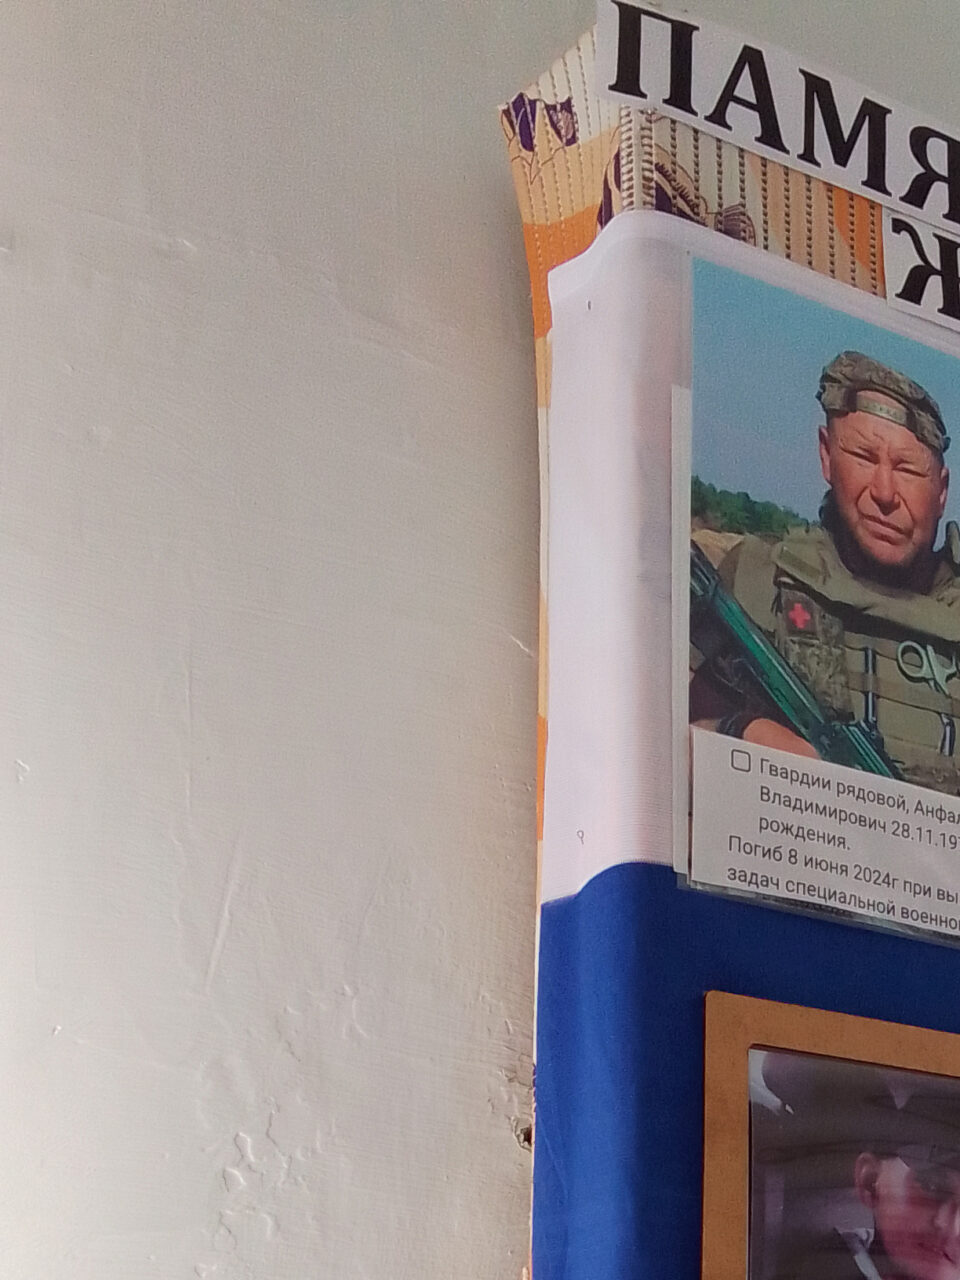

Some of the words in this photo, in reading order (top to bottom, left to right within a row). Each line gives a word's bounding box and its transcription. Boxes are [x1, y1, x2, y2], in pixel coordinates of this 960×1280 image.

[759, 786, 887, 833] Владимирович
[760, 758, 831, 791] Гвардии
[836, 781, 910, 815] рядовой,
[759, 816, 851, 850] рождения.
[727, 867, 780, 890] задач
[785, 879, 895, 917] специальной
[729, 836, 783, 863] Погиб
[788, 847, 798, 864] 8
[804, 854, 848, 877] июня
[853, 864, 899, 890] 2024г
[903, 879, 931, 899] при
